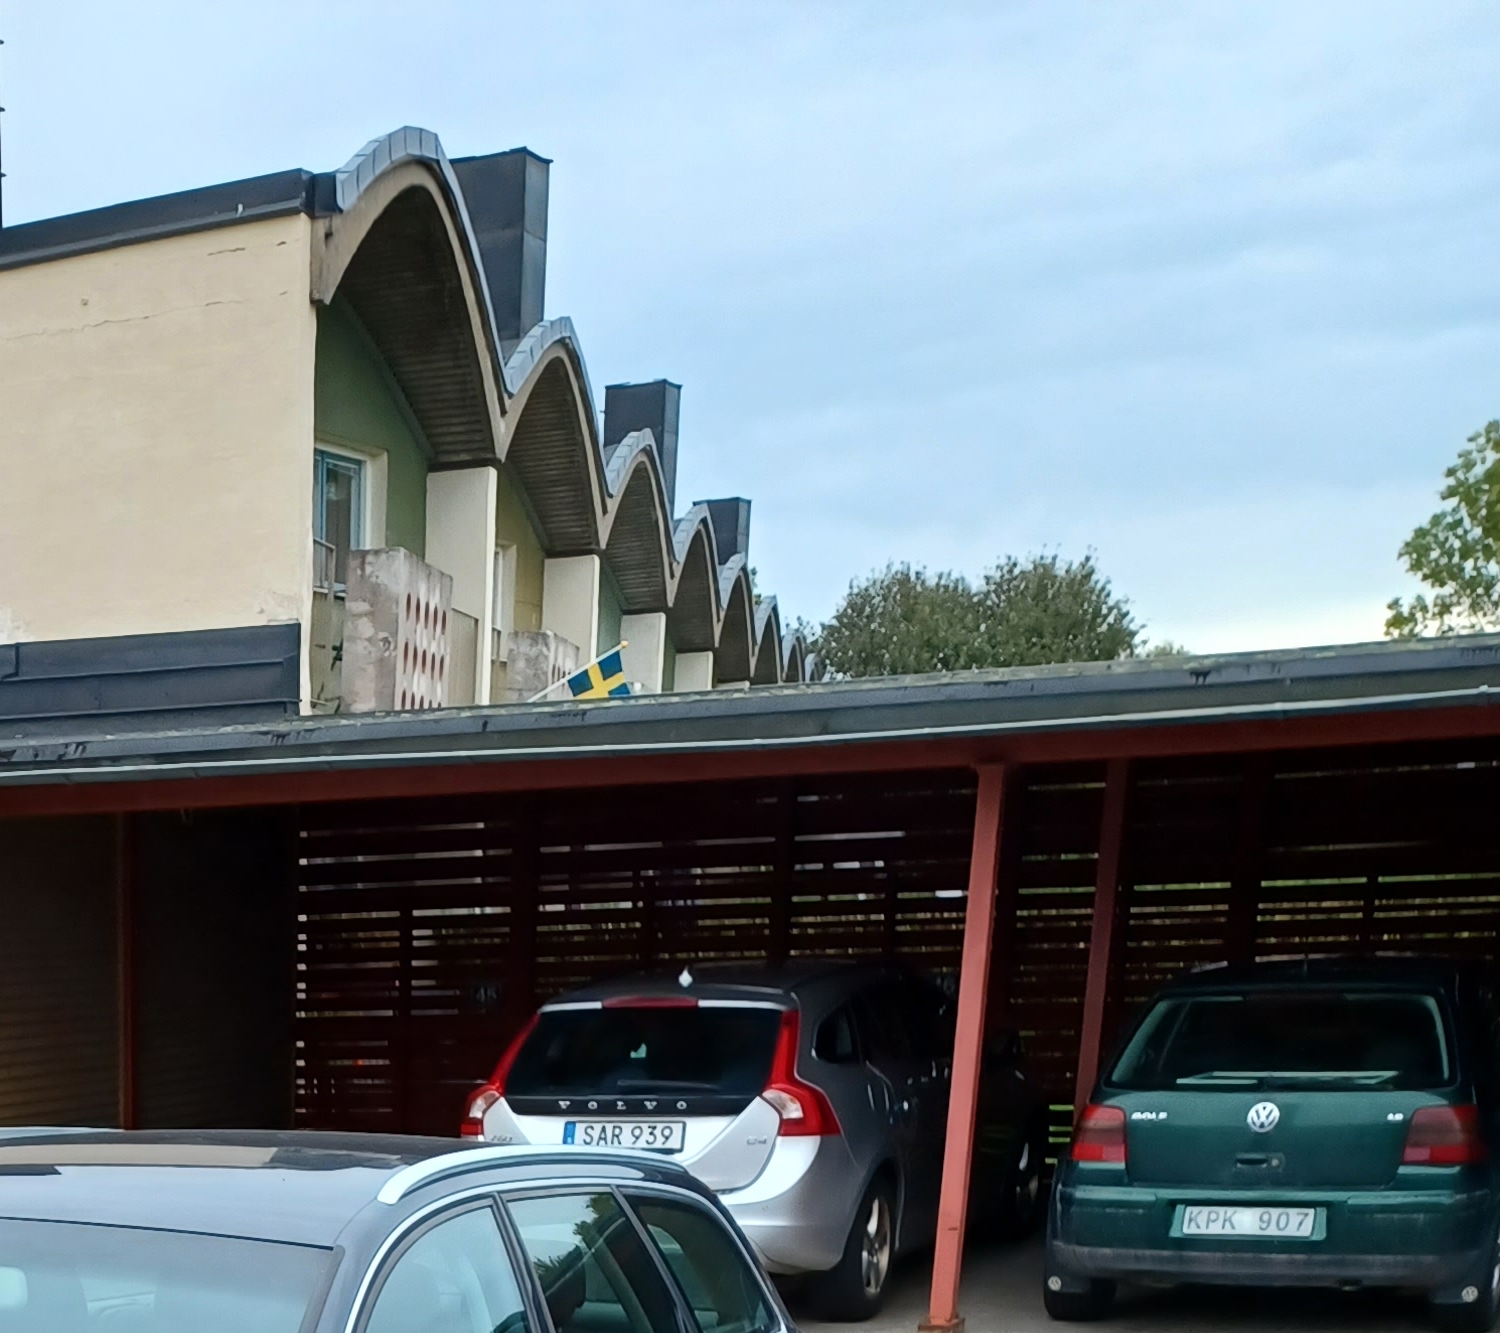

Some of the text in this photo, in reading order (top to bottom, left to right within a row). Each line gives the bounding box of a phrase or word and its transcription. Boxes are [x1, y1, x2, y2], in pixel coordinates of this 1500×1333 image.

[558, 1100, 688, 1110] VOLVO
[582, 1125, 674, 1146] SAR 939
[1186, 1209, 1310, 1232] KPK 907
